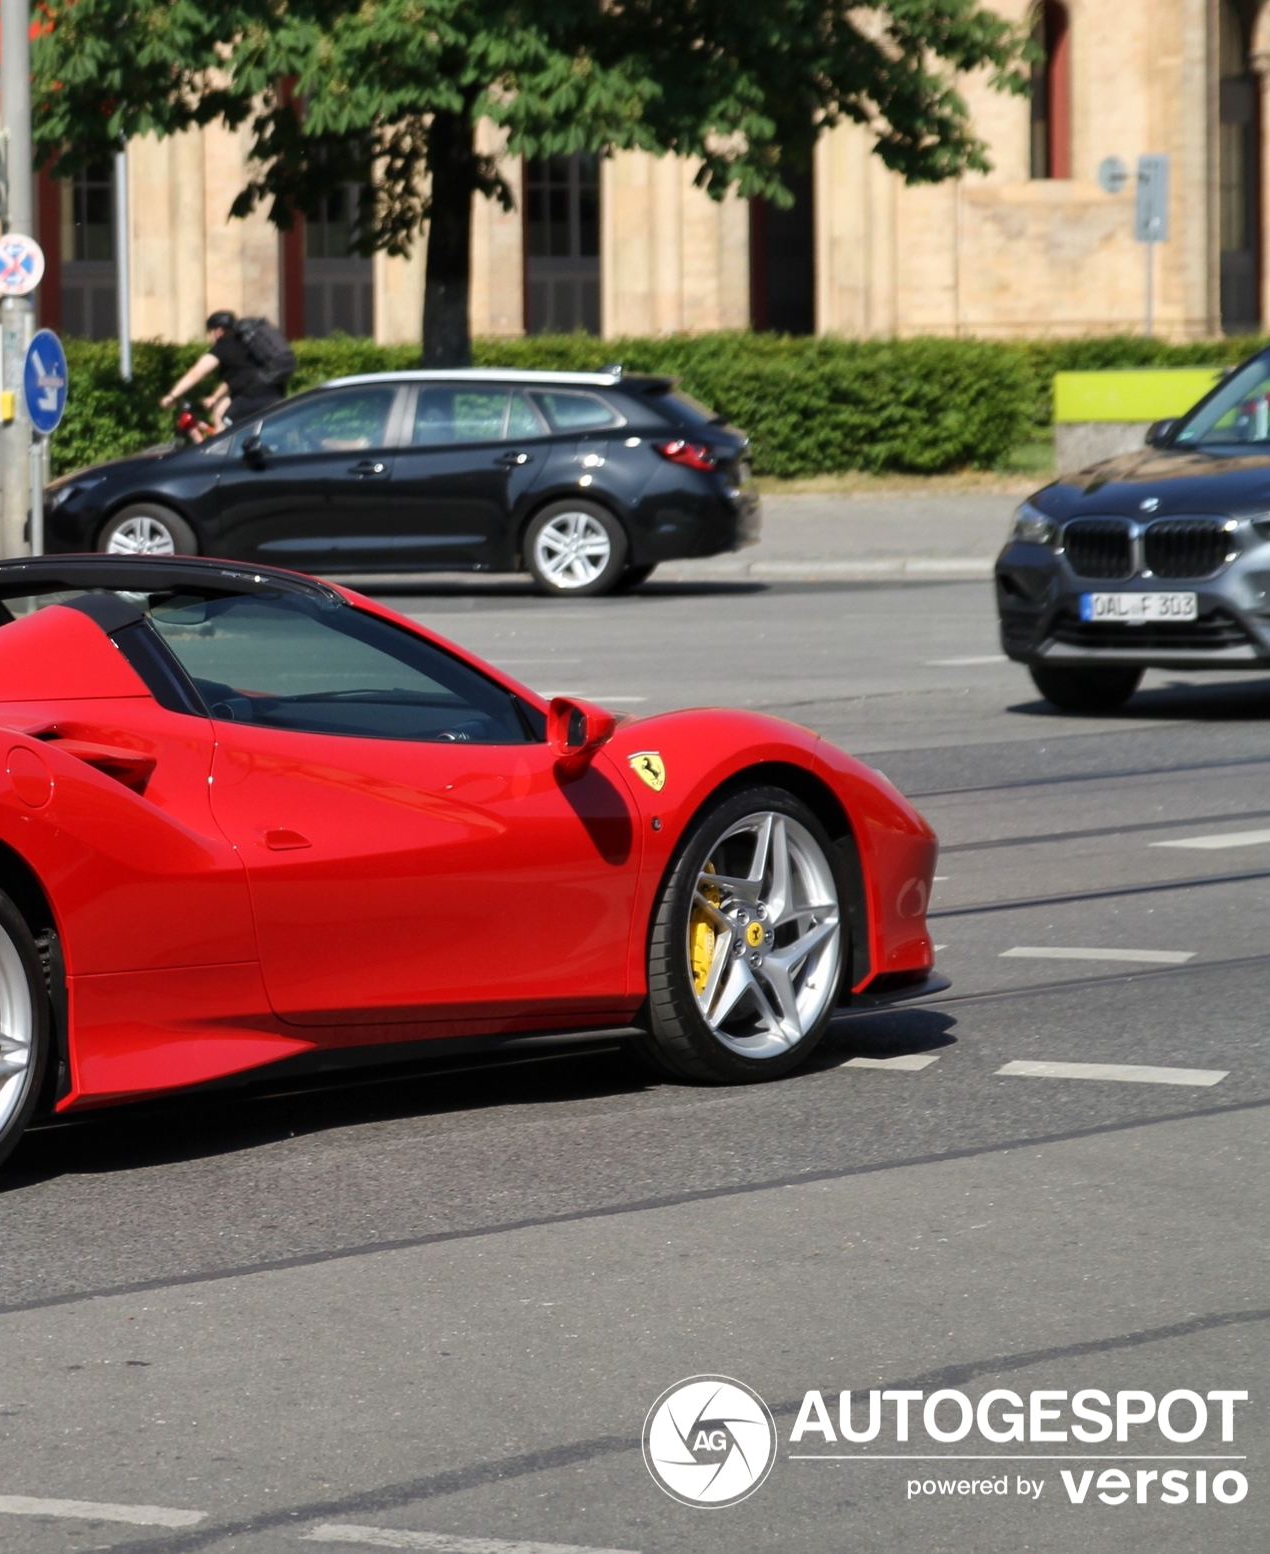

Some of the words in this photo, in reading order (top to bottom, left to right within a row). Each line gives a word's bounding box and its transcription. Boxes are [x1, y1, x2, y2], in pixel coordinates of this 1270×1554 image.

[1094, 596, 1129, 616] OAL
[1141, 596, 1153, 615] F
[1159, 596, 1194, 616] 303
